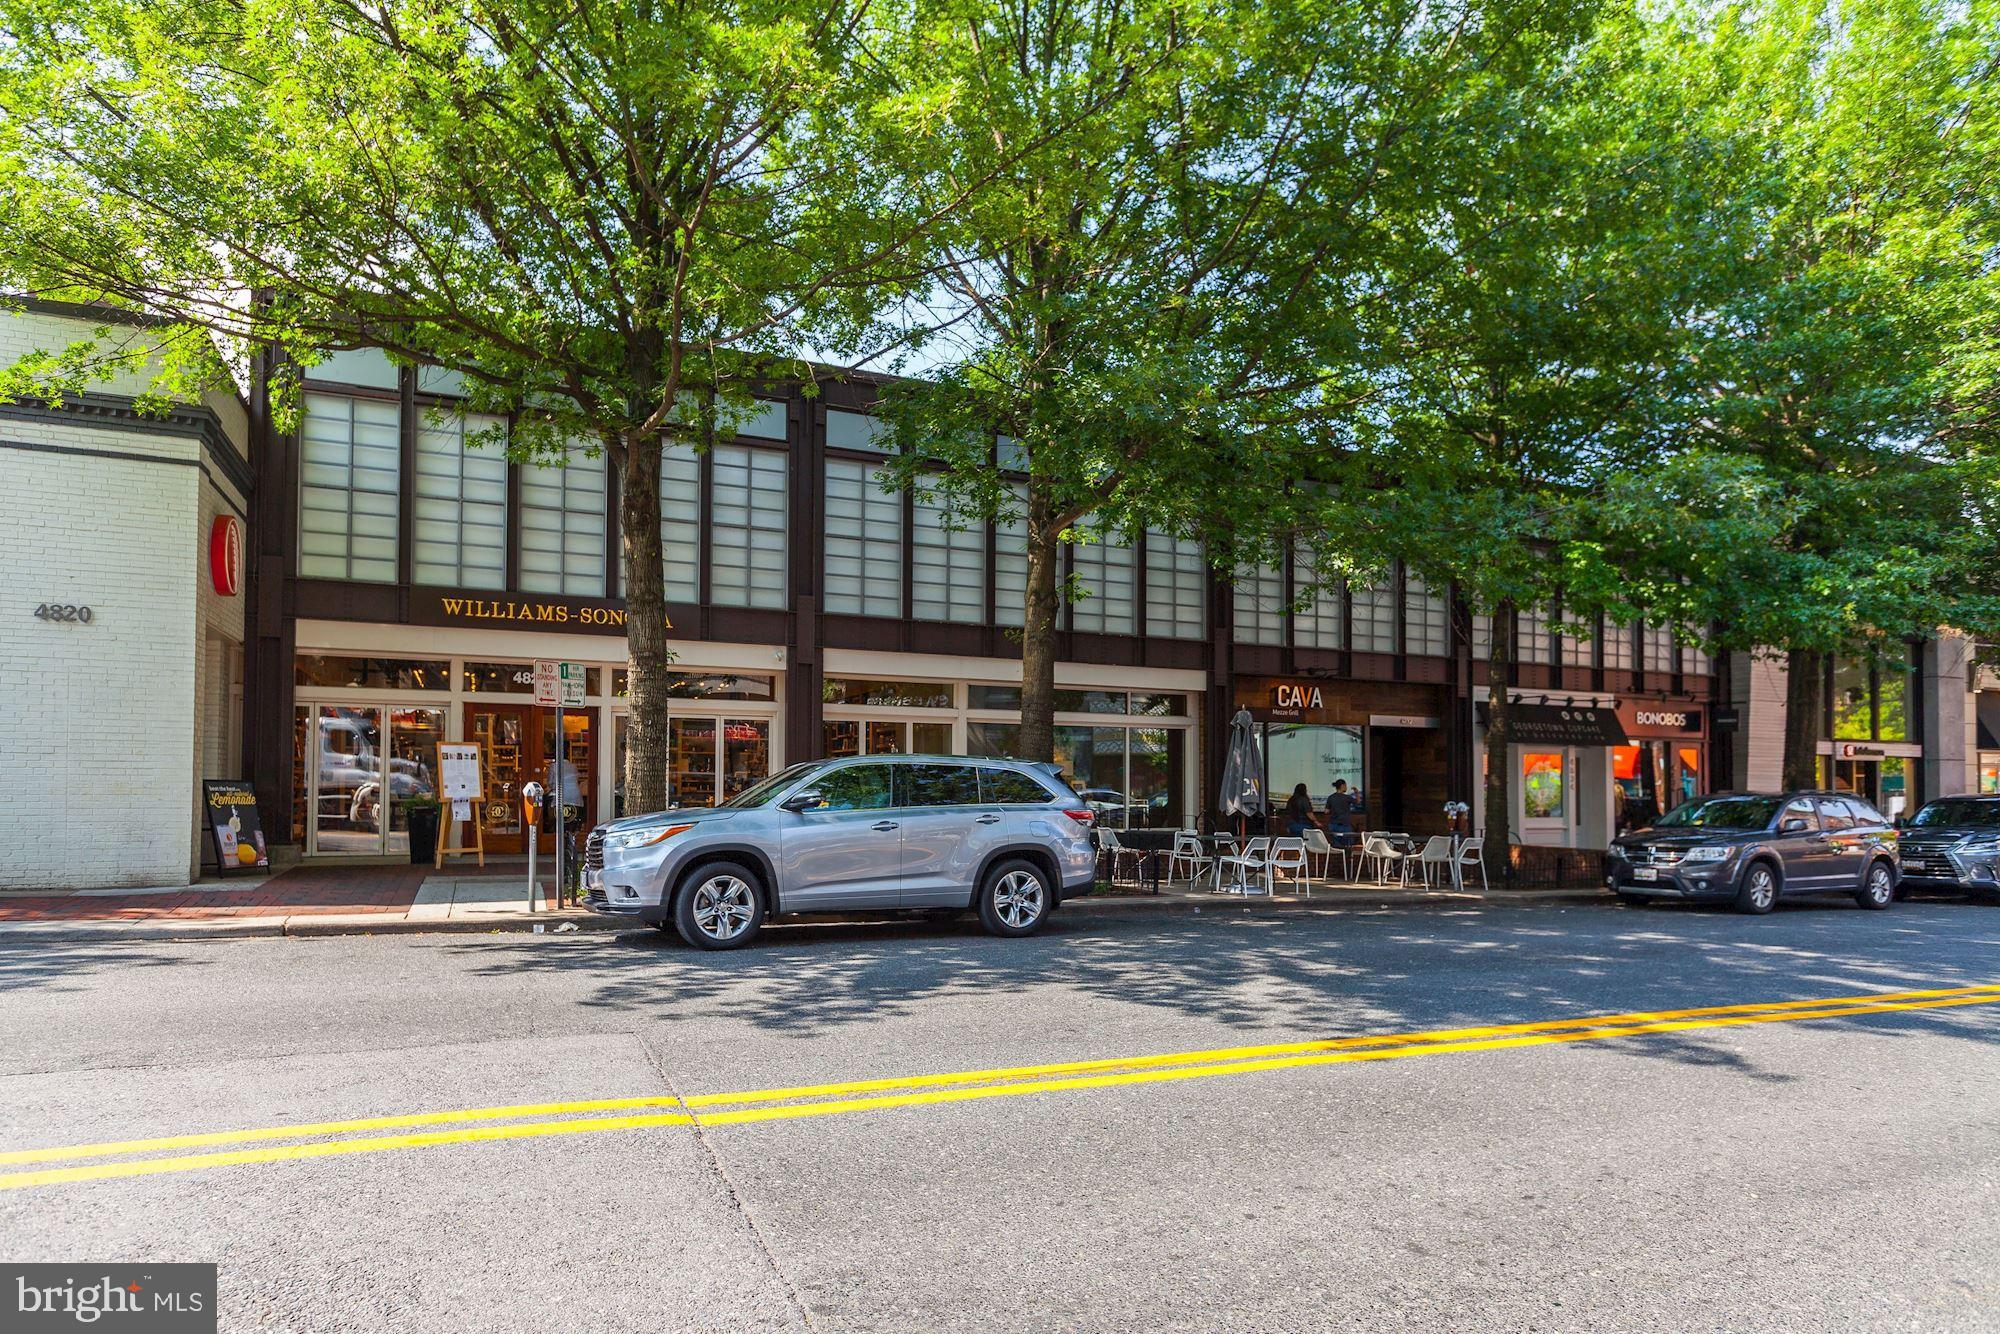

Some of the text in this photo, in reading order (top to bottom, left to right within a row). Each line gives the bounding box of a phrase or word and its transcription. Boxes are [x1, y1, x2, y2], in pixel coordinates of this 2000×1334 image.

[34, 604, 92, 624] 4820
[442, 598, 674, 629] WILLIAMS-SONA
[541, 663, 553, 674] NO
[537, 674, 558, 682] STANDING
[541, 689, 554, 697] TIME
[1278, 685, 1323, 708] CAVA
[1636, 711, 1687, 727] BONOBOS
[210, 791, 257, 808] Lemonade
